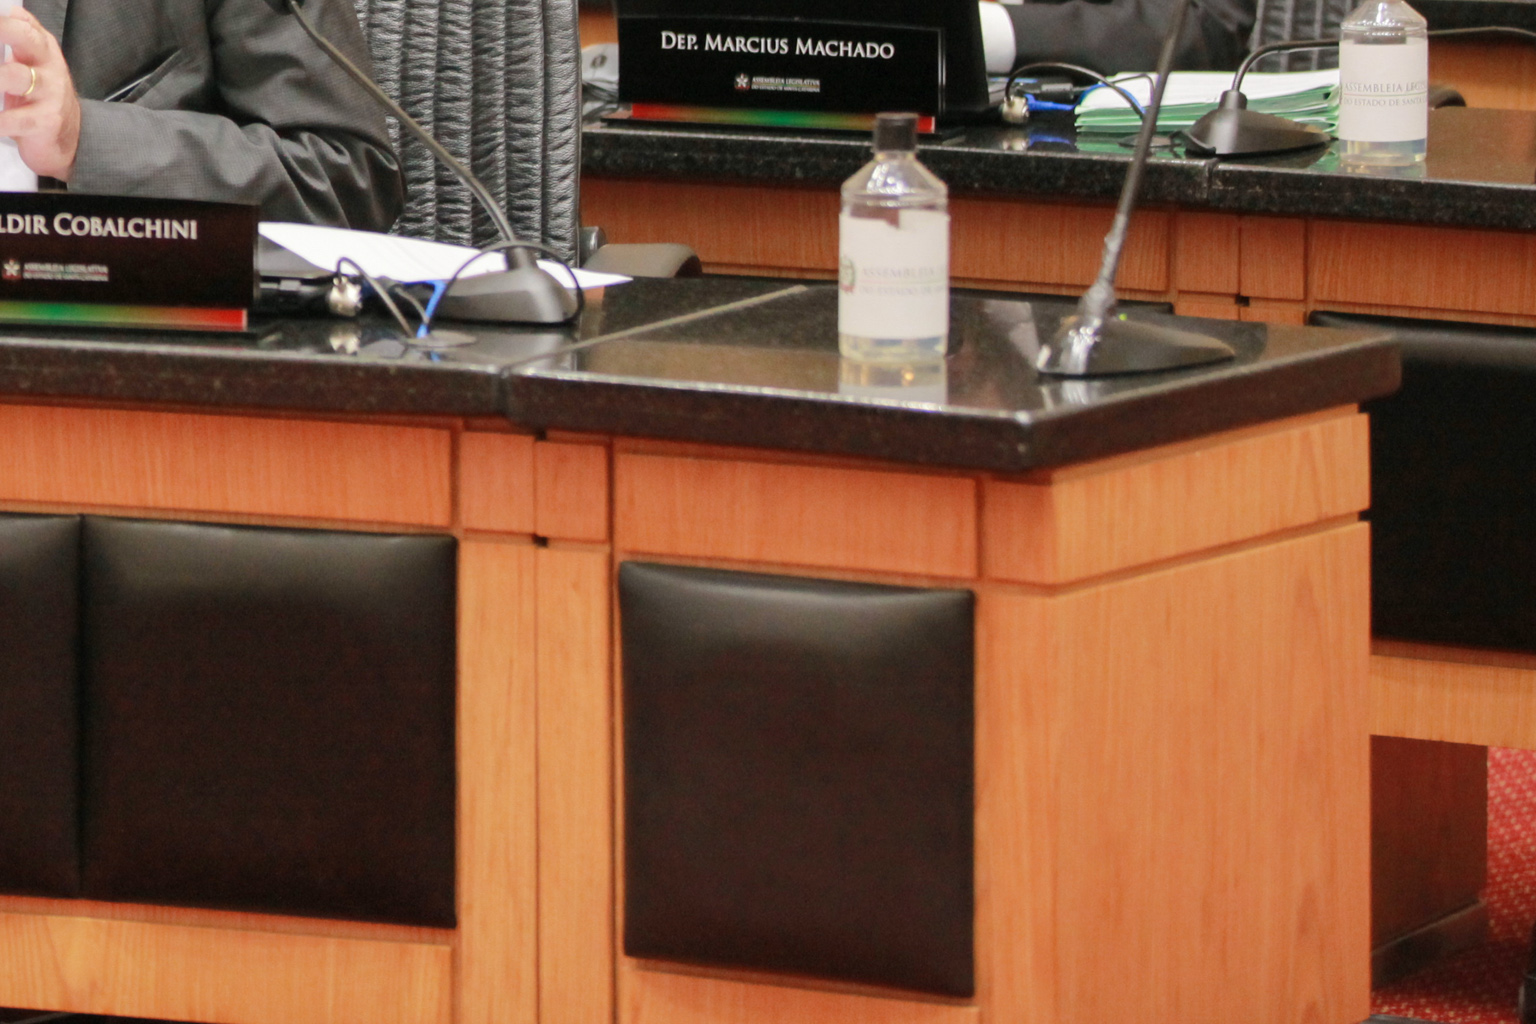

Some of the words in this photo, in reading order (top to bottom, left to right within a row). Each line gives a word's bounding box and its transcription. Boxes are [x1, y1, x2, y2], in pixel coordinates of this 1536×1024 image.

[660, 31, 699, 51] DEP.
[704, 33, 789, 55] MARCIUS
[795, 37, 895, 60] MACHADO
[1345, 82, 1402, 93] ASSEMBLEIA
[1354, 98, 1386, 107] ESTADO
[1388, 98, 1399, 107] DE
[53, 212, 198, 240] COBALCHINI
